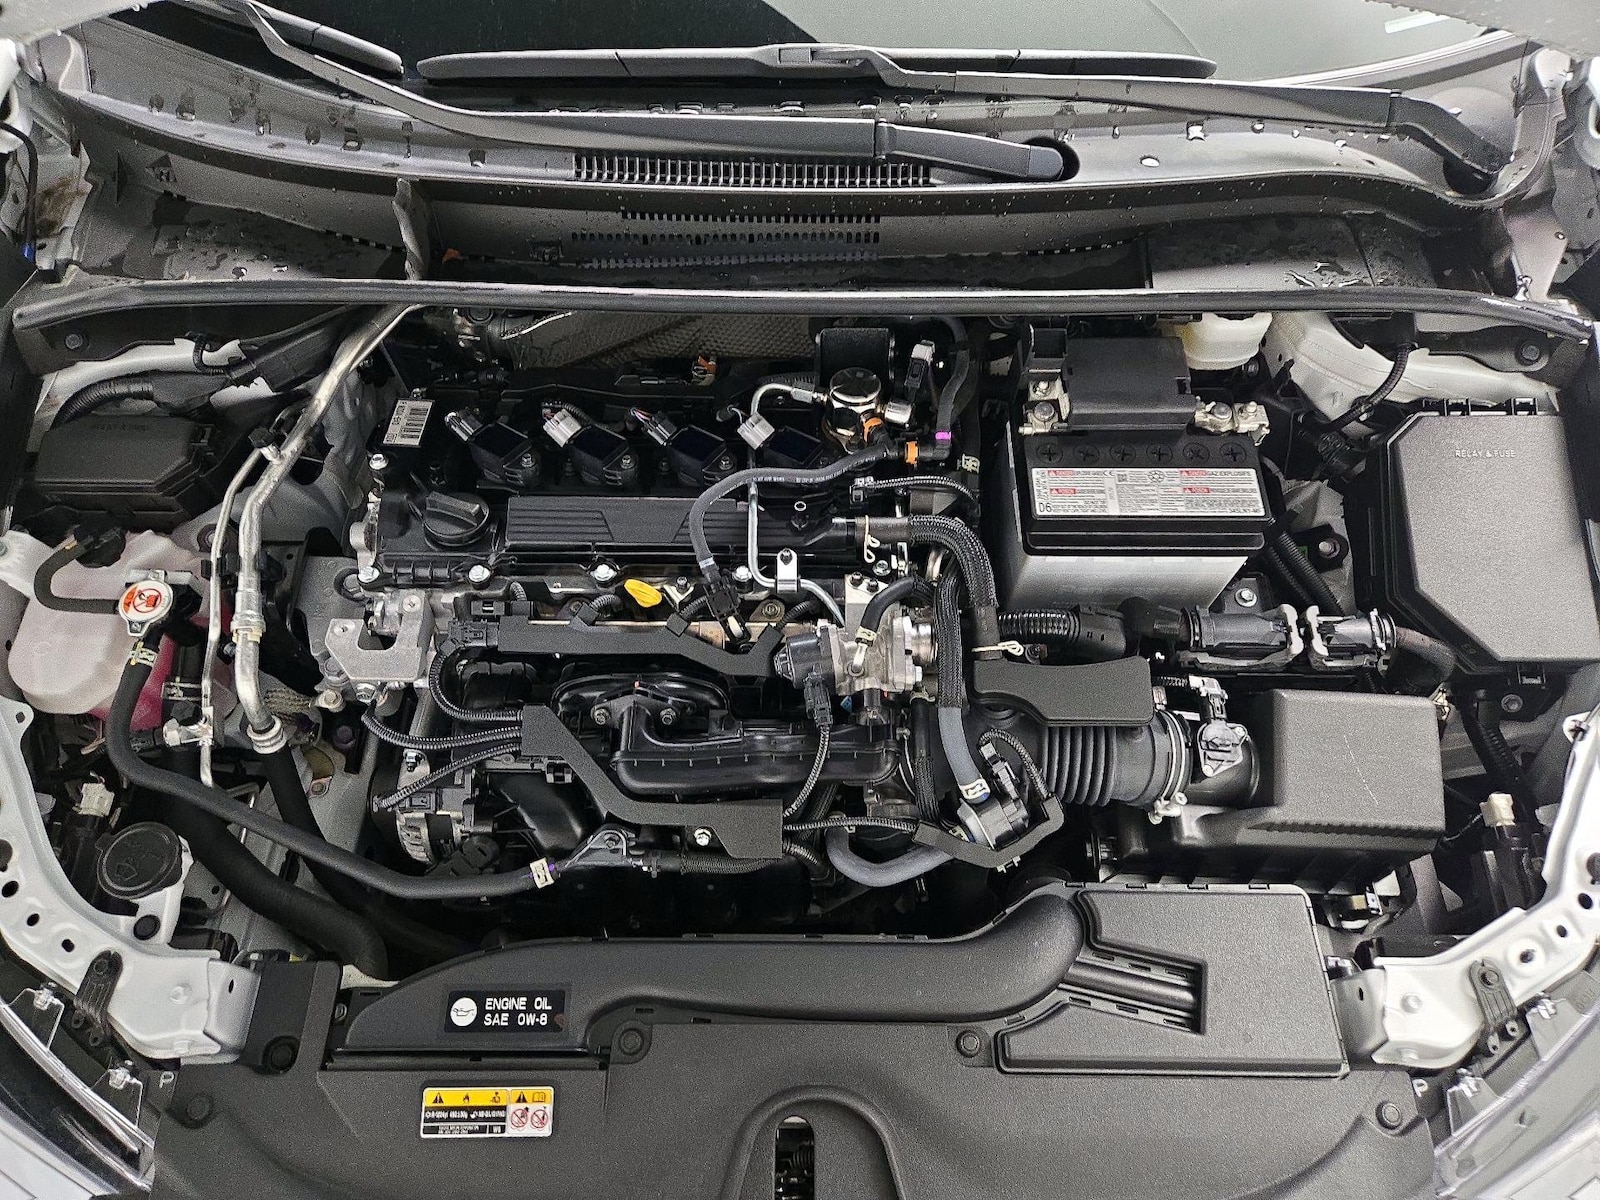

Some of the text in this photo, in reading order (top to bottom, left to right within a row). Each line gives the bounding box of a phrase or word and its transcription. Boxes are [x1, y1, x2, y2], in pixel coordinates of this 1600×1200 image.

[1455, 449, 1517, 458] RELAY & FUSE
[485, 997, 552, 1011] ENGINE OIL
[483, 1013, 548, 1026] SAE 0W-8
